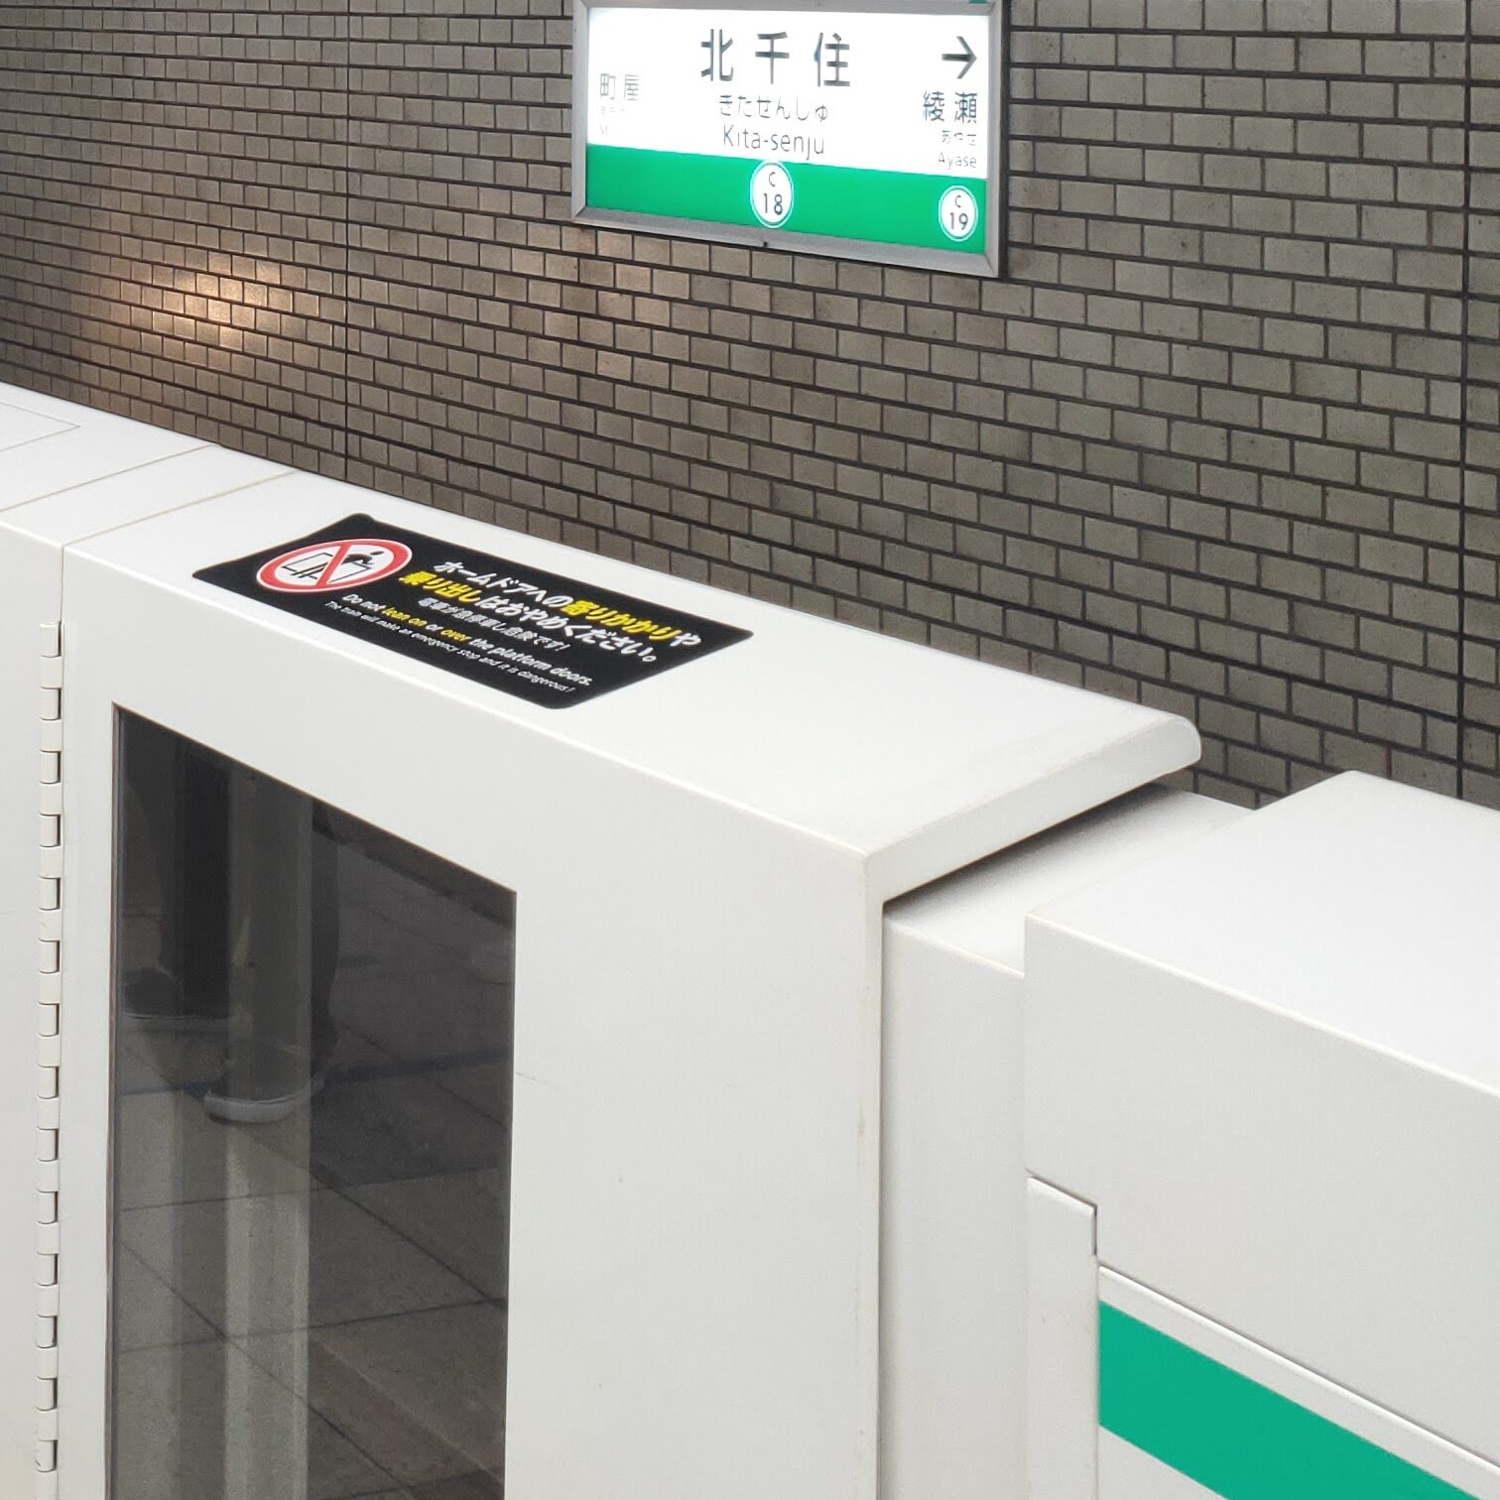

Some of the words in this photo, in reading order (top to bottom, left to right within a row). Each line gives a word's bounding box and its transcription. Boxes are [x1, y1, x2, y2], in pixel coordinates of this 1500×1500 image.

[700, 28, 851, 87] 北千住
[599, 73, 640, 101] 町屋
[923, 90, 978, 124] 綾瀬
[723, 124, 825, 161] Kita-senju
[938, 152, 977, 170] Ayase
[768, 171, 777, 188] C
[763, 193, 784, 215] 18
[954, 195, 962, 208] C
[950, 212, 969, 231] 19
[434, 561, 701, 647] ホームドアへの寄りかかりや
[342, 594, 363, 604] Do
[360, 601, 387, 611] not
[381, 607, 411, 621] lean
[408, 618, 428, 627] on
[425, 624, 444, 632] or
[440, 629, 473, 641] over
[469, 638, 495, 650] the
[487, 647, 553, 671] platform
[549, 667, 593, 686] doors.
[411, 633, 460, 652] emergency
[456, 649, 481, 660] stop
[478, 657, 502, 666] and
[517, 671, 576, 693] dangerous!
